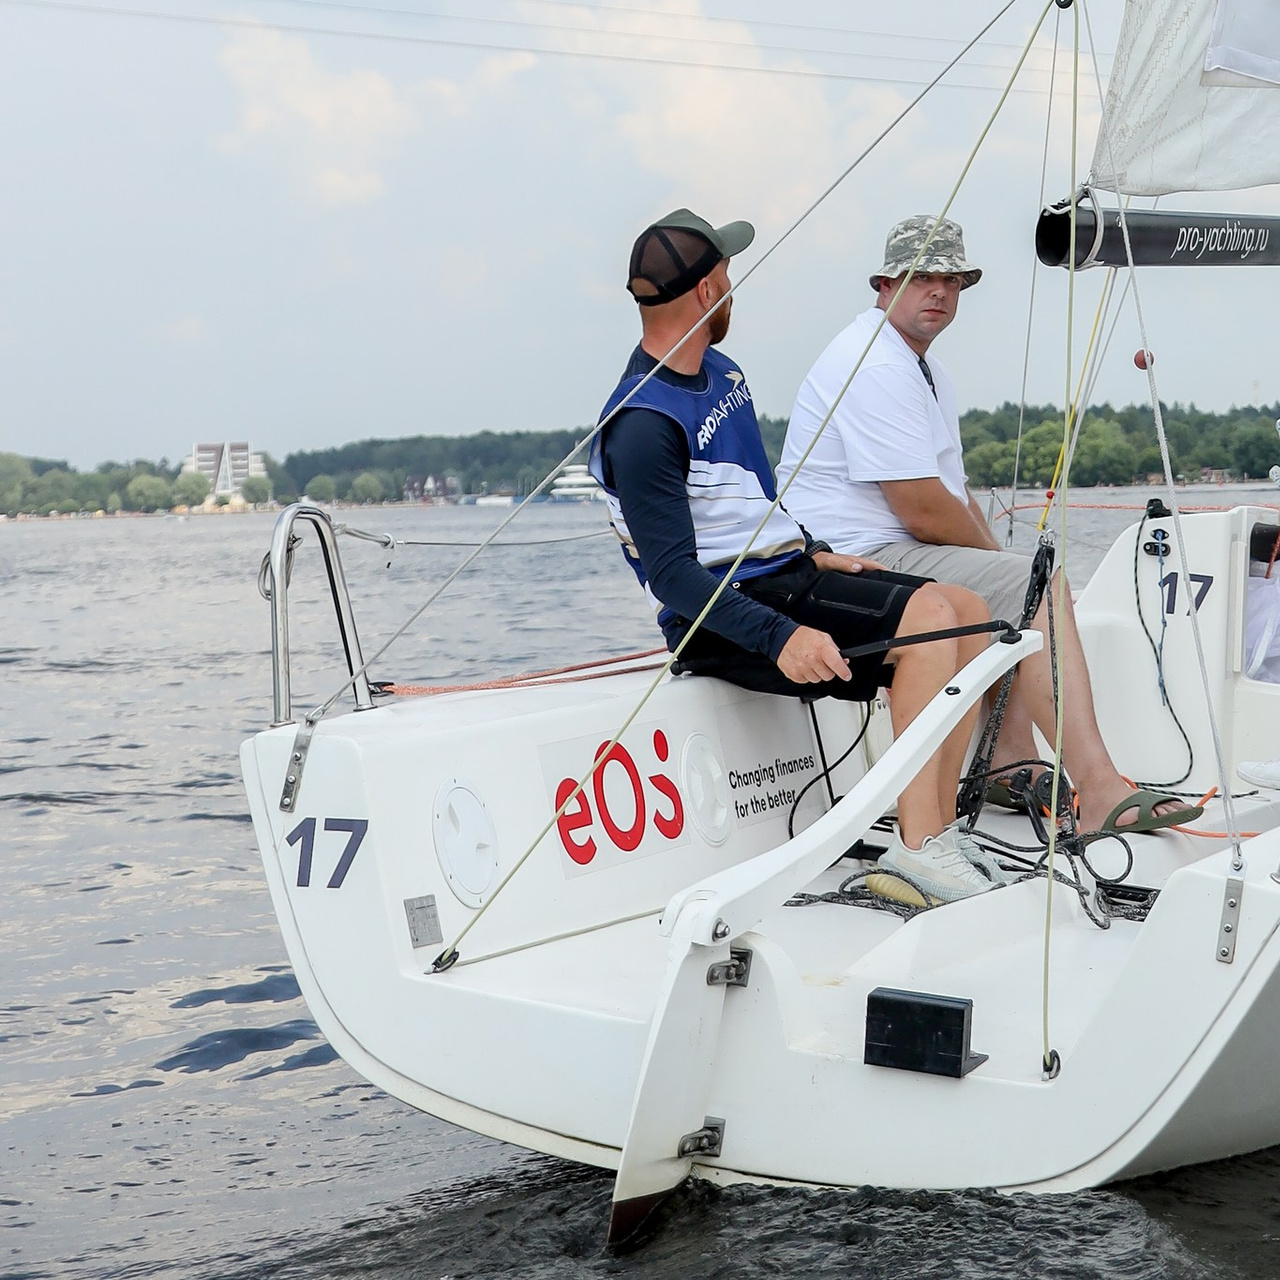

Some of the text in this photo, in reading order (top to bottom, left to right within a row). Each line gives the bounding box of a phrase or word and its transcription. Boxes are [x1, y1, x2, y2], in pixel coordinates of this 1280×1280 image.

[1170, 220, 1270, 259] pro-yachting.ru
[1158, 572, 1214, 616] 17
[728, 755, 815, 789] Changing finances
[735, 789, 797, 819] for the better
[285, 817, 368, 888] 17
